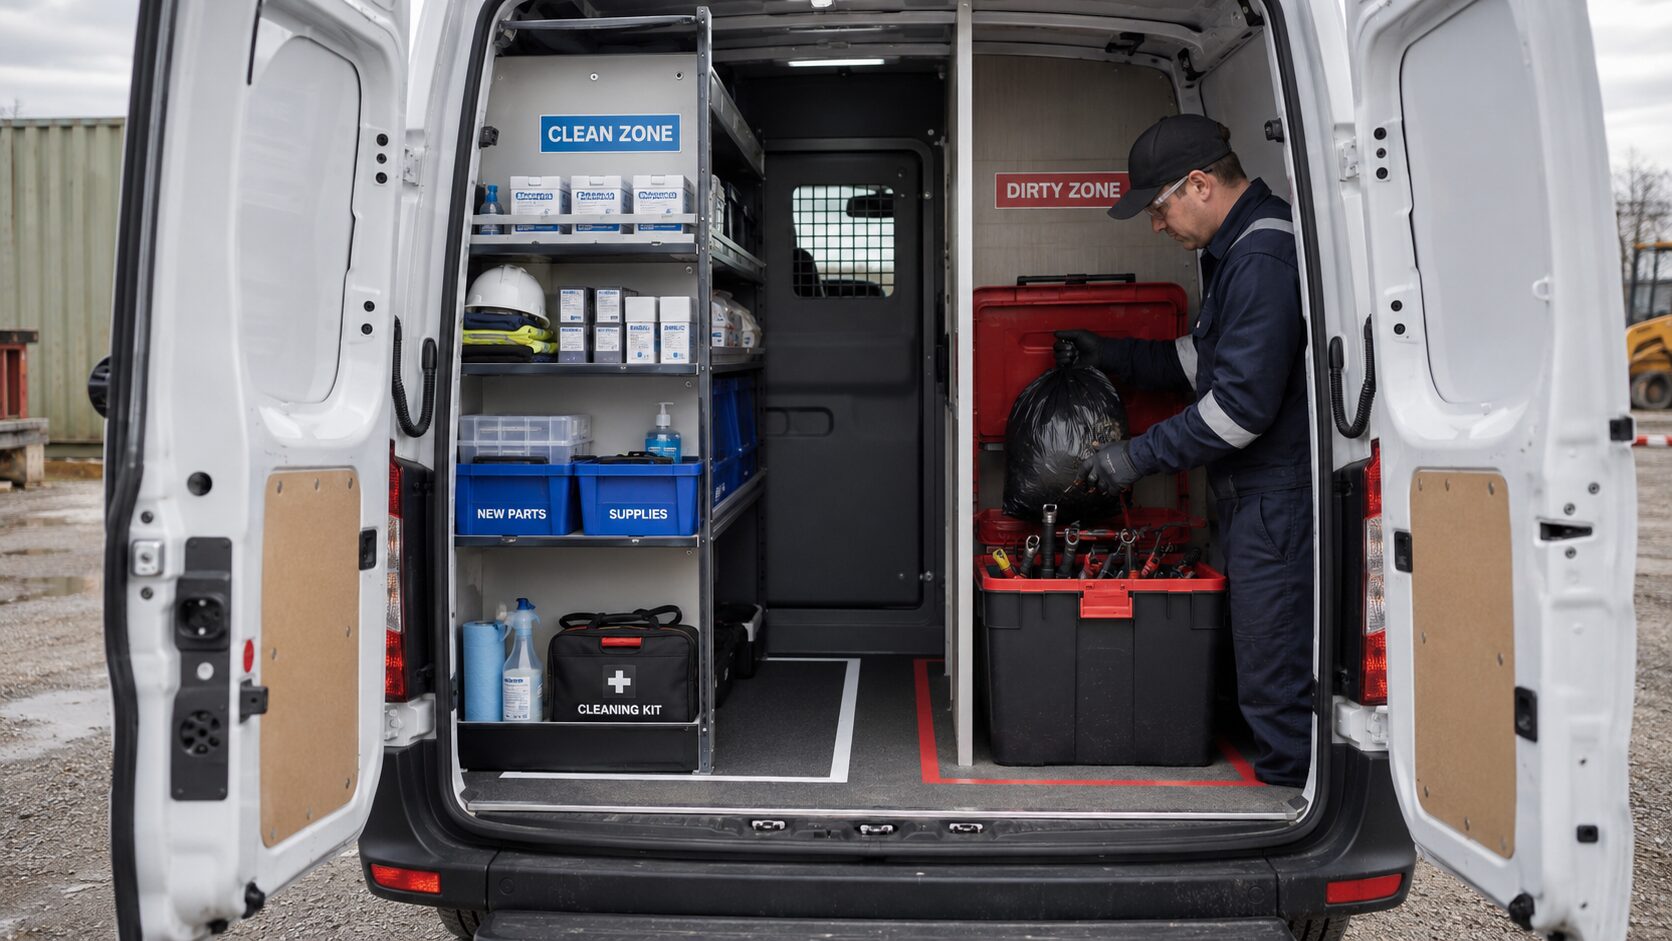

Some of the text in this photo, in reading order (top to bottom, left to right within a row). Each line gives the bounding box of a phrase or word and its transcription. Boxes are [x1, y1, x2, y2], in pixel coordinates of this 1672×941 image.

[548, 125, 673, 143] CLEAN ZONE
[1007, 182, 1121, 199] DIRTY ZONE
[477, 508, 547, 520] NEW PARTS
[609, 508, 668, 520] SUPPLIES
[577, 703, 663, 715] CLEANING KIT
